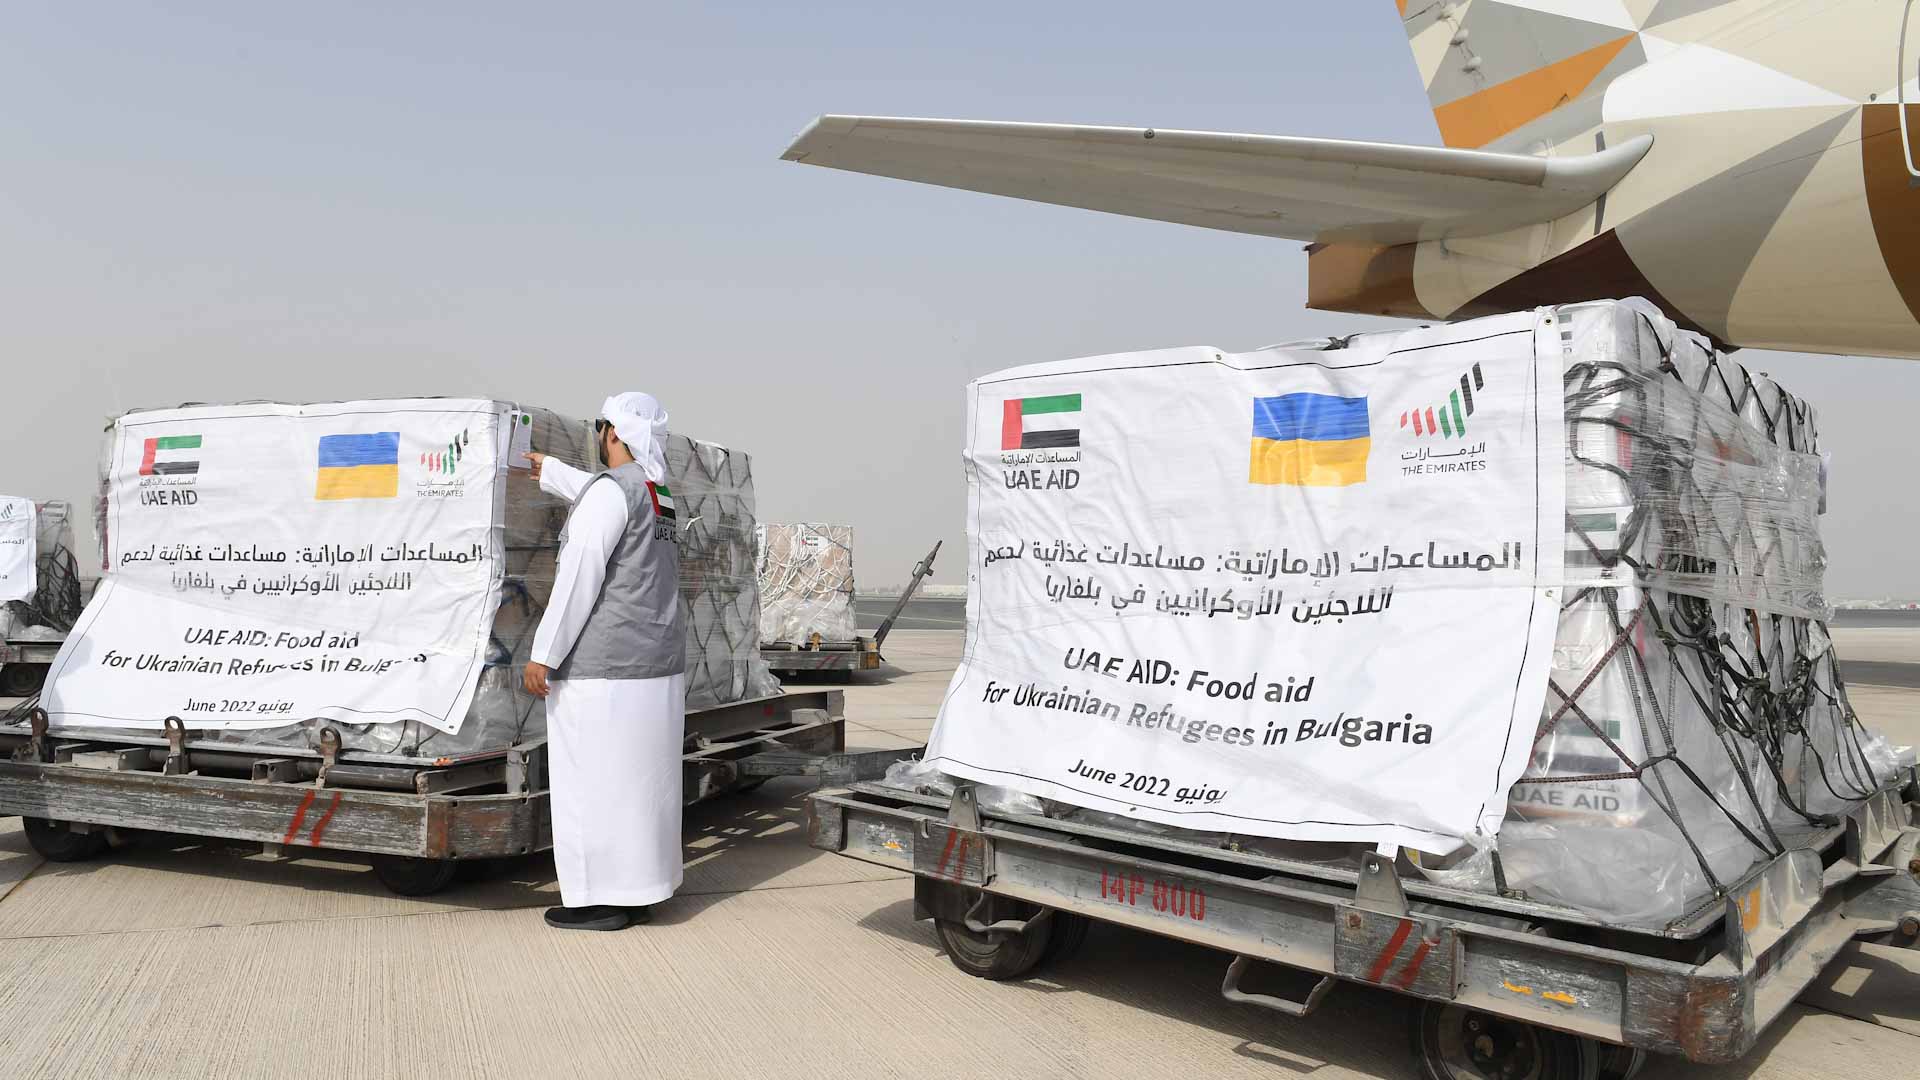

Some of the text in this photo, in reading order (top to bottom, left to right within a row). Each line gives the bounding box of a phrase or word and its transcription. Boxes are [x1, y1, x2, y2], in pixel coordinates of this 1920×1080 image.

[1035, 451, 1081, 463] المساعدات
[1402, 460, 1487, 477] THE EMIRATES
[1003, 469, 1080, 490] UAE AID
[140, 489, 198, 505] UAE AID
[428, 489, 465, 498] EMIRATES
[655, 527, 669, 541] UAE
[120, 543, 156, 567] لدعم
[158, 543, 204, 566] غذائية
[208, 543, 287, 563] مساعدات
[380, 542, 483, 564] المساعدات
[984, 539, 1025, 568] لدعم
[1032, 539, 1088, 568] غذائية
[1096, 542, 1205, 571] مساعدات
[1350, 541, 1521, 573] المساعدات
[220, 573, 248, 600] في
[252, 570, 341, 597] الأوكرانيين
[348, 571, 412, 596] اللاجئين
[1045, 574, 1394, 625] اللاجئين الأوكرانيين في بلغاريا
[183, 627, 361, 650] UAE AID: Food aid
[101, 650, 132, 669] for
[135, 653, 224, 675] Ukrainian
[320, 654, 341, 673] in
[1063, 647, 1315, 703] UAE AID: Food aid
[183, 698, 295, 715] June 2022 يونيو
[982, 681, 1433, 748] for Ukrainian Refugees in Bulgaria
[1068, 759, 1228, 805] June 2022 يونيو
[1510, 786, 1564, 806] UAE
[1573, 793, 1620, 812] AID
[1101, 867, 1206, 921] 14P 800
